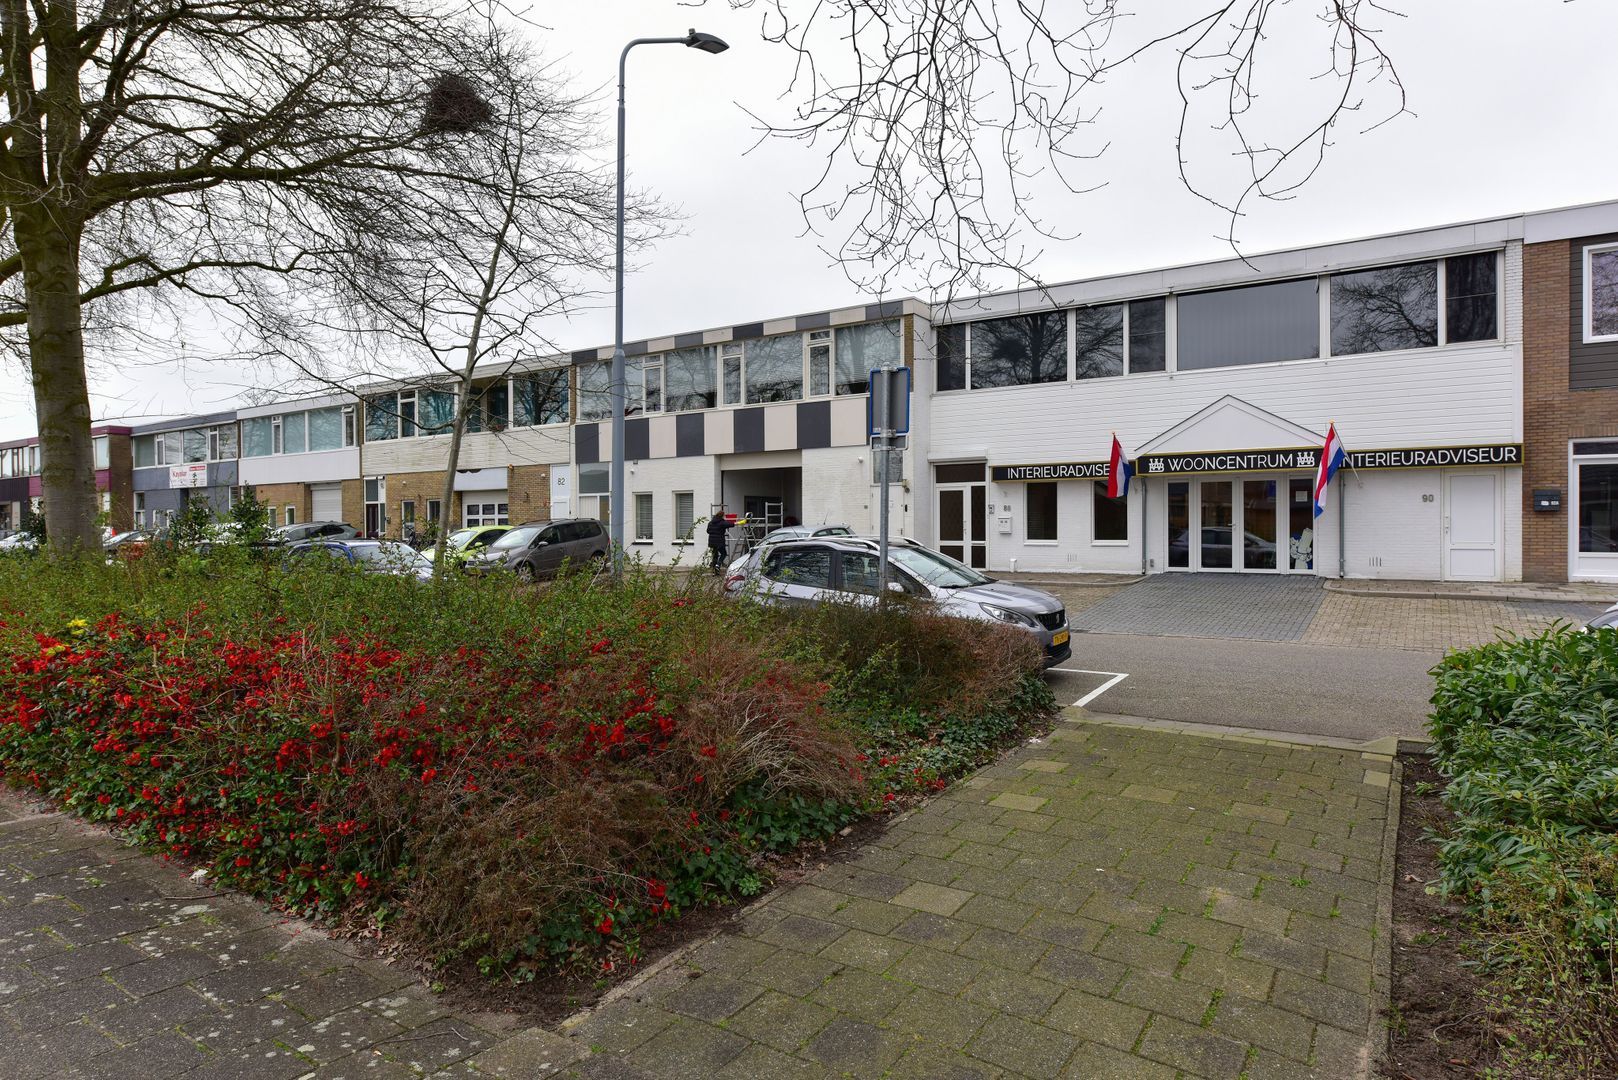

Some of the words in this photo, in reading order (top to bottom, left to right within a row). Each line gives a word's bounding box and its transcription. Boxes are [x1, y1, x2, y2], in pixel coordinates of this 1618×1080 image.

[1168, 454, 1293, 471] WOONCENTRUM
[1007, 463, 1111, 479] INTERIEURADVISE
[557, 477, 566, 485] 82
[1421, 494, 1434, 503] 90
